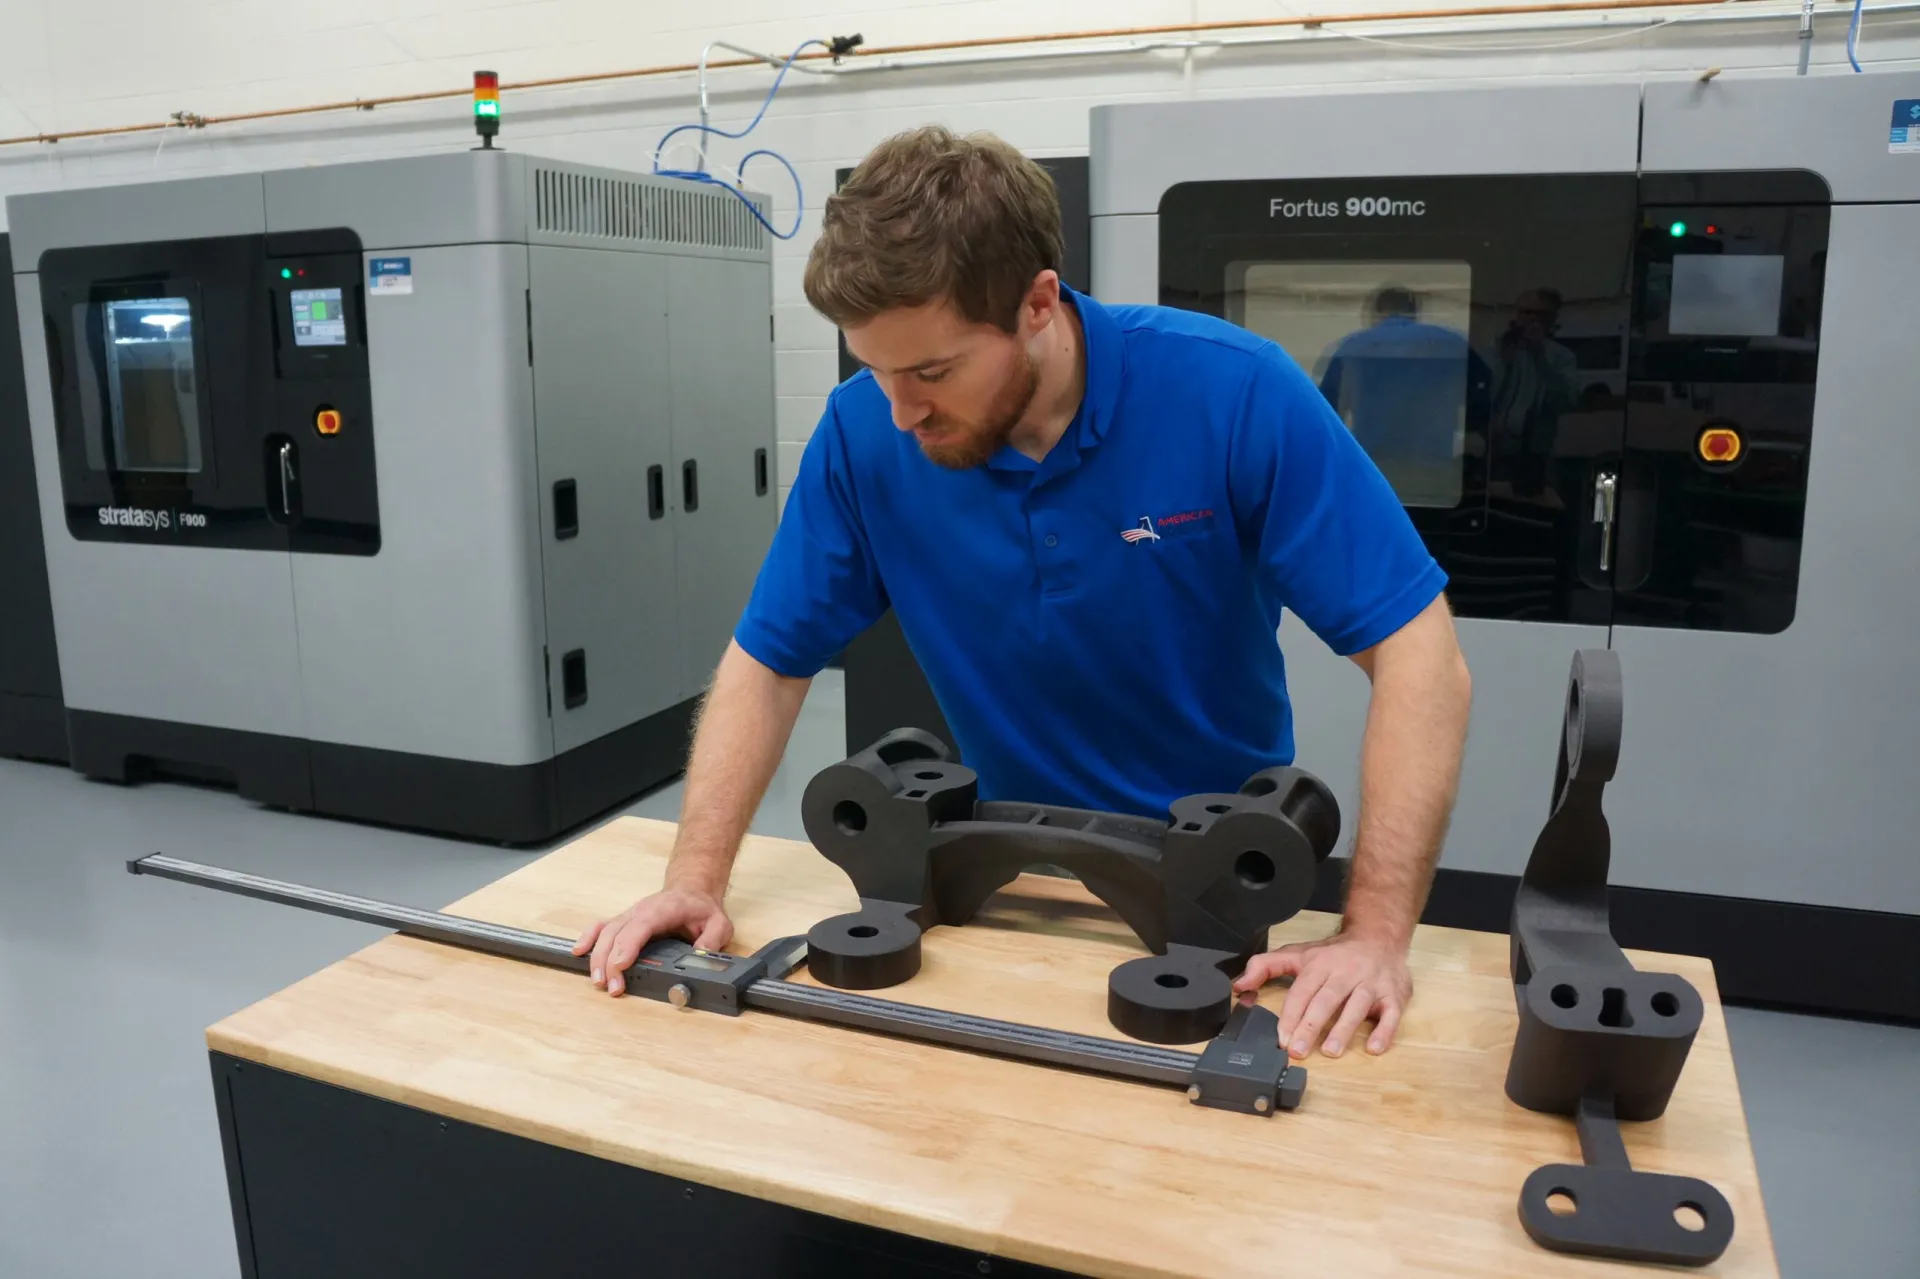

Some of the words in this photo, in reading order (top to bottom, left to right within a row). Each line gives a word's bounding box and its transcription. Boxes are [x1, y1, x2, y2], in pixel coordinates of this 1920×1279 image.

[1270, 198, 1339, 217] Fortus
[1345, 197, 1425, 216] 900mc
[98, 505, 170, 531] stratasys
[180, 513, 206, 527] F900
